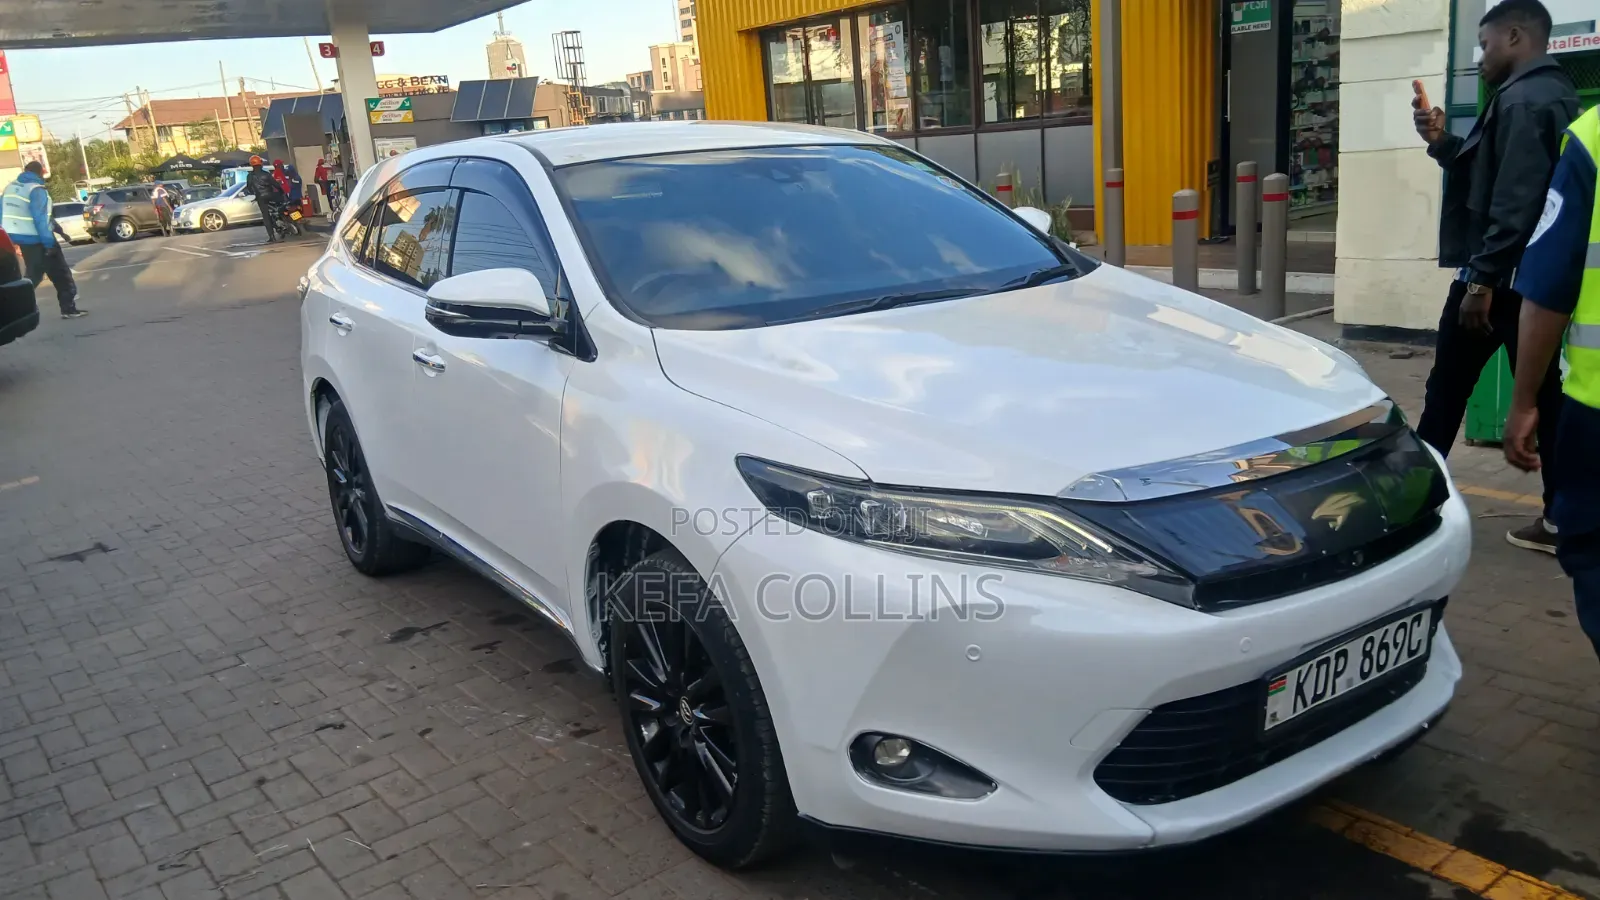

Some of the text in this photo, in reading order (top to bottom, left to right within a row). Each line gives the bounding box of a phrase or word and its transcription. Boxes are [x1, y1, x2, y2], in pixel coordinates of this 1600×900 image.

[1231, 24, 1252, 32] ILABLE
[372, 43, 382, 54] 4
[1547, 35, 1600, 50] otalEne
[323, 45, 332, 56] 3
[376, 74, 447, 90] GG & BEAN
[1292, 612, 1424, 714] KDP 869C
